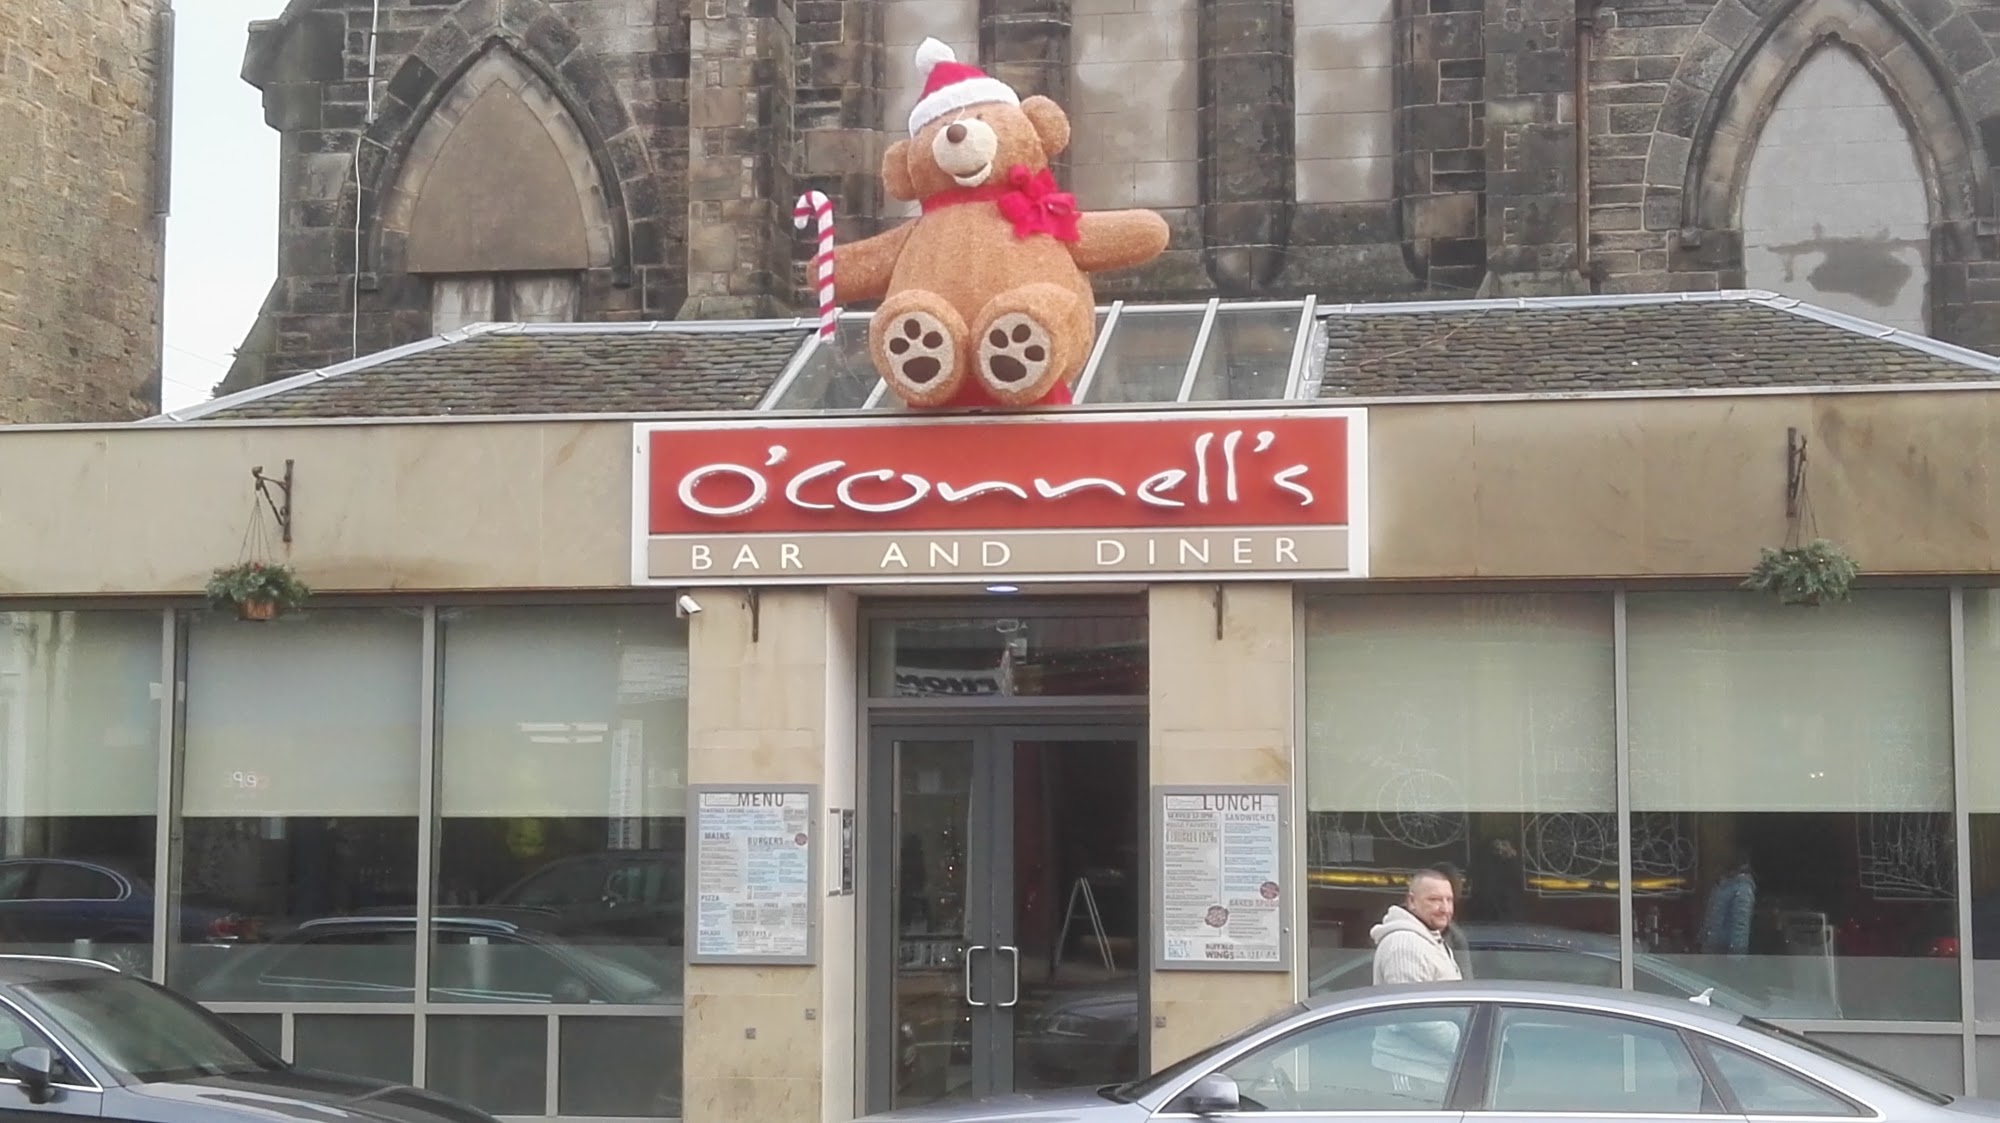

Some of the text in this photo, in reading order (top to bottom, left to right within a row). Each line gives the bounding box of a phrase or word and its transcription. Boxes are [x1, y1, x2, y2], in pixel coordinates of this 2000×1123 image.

[690, 537, 1300, 571] BAR AND DINER
[738, 792, 784, 807] MENU
[1203, 794, 1262, 811] LUNCH
[1225, 813, 1276, 821] SANDWICHES
[704, 831, 730, 840] MAINS
[747, 837, 783, 845] BURGERS
[1205, 951, 1234, 960] WINGS
